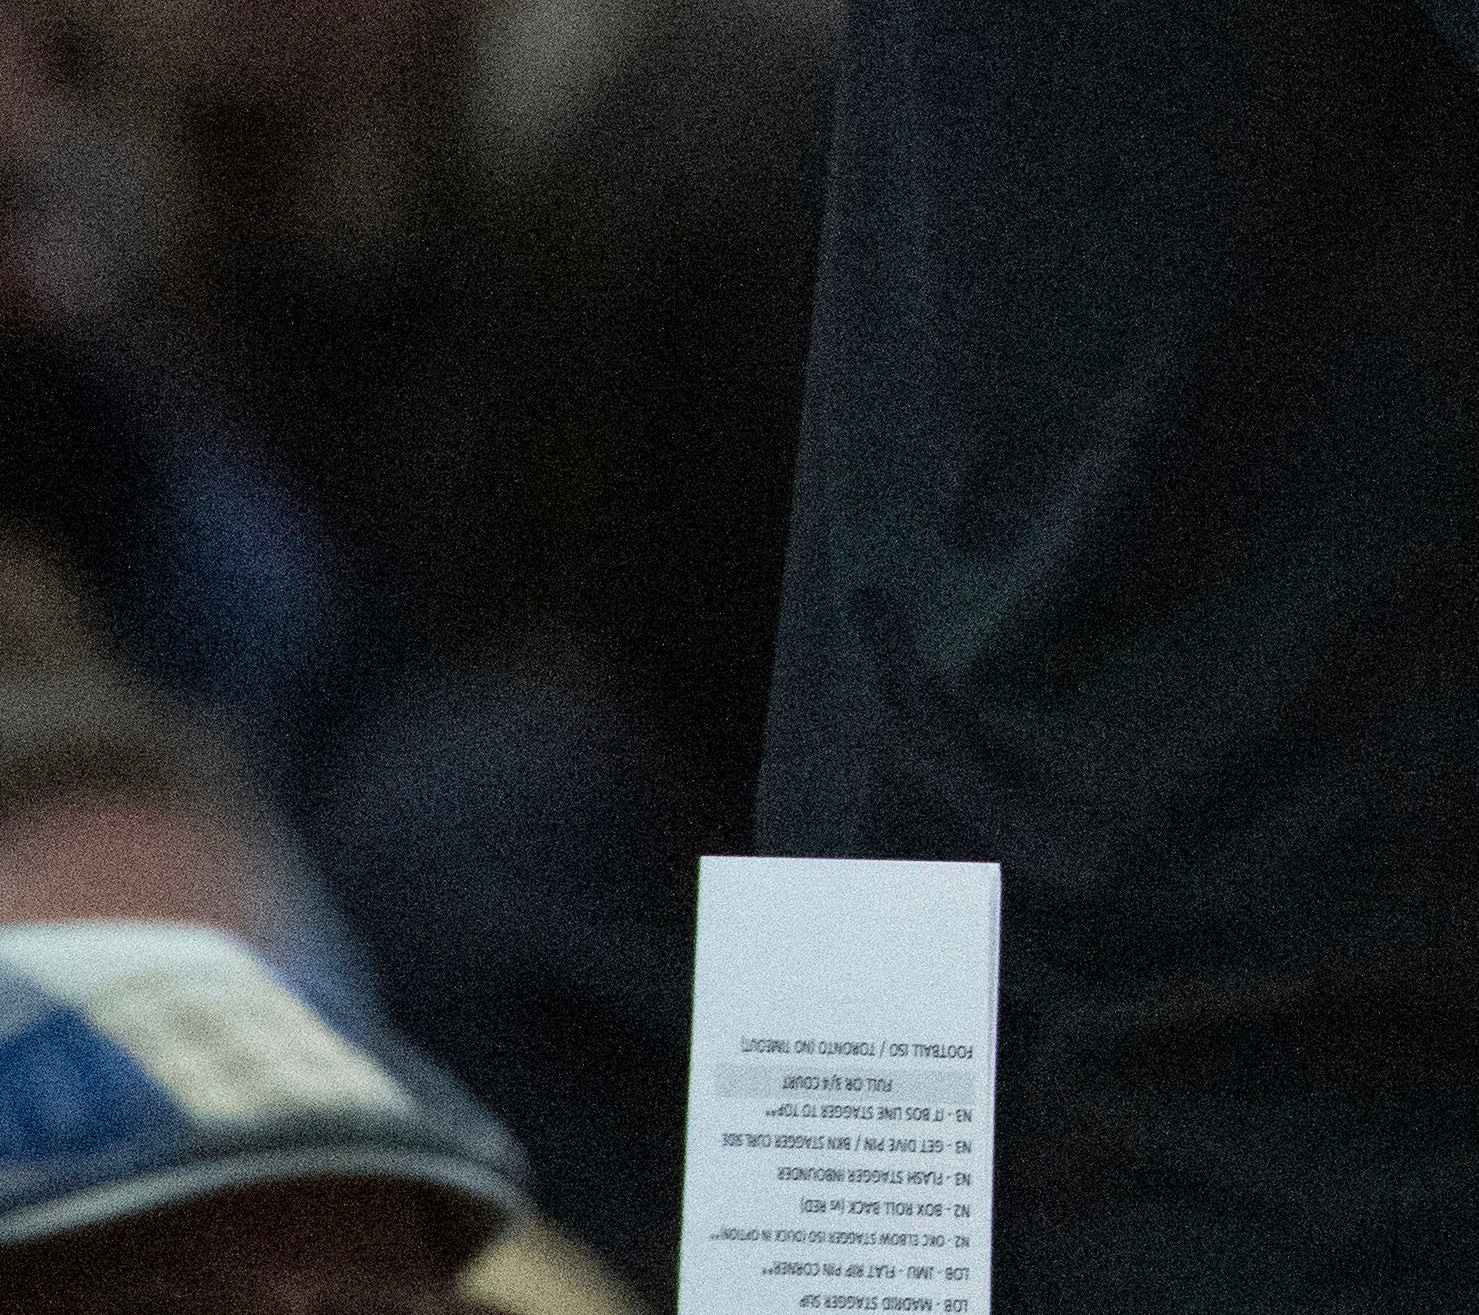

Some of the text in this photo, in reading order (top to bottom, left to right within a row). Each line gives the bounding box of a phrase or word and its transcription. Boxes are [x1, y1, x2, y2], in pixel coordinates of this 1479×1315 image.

[818, 1041, 875, 1056] TORONTO
[889, 1043, 908, 1057] ISO
[912, 1044, 973, 1059] FOOTBALL
[782, 1074, 892, 1093] FULL OR 3/4 COURT
[802, 1104, 817, 1118] TO
[821, 1105, 874, 1120] STAGGER
[877, 1106, 902, 1120] LINE
[905, 1107, 930, 1121] BOS
[956, 1109, 972, 1122] N3
[774, 1135, 824, 1150] STAGGER
[864, 1138, 884, 1151] PIN
[888, 1138, 917, 1152] DIVE
[920, 1140, 944, 1153] GET
[955, 1140, 972, 1154] N3
[848, 1169, 903, 1184] STAGGER
[908, 1171, 943, 1186] FLASH
[955, 1172, 970, 1186] N3
[848, 1201, 880, 1215] BACK
[885, 1202, 913, 1216] ROLL
[917, 1203, 942, 1217] BOX
[954, 1204, 970, 1218] N2
[829, 1232, 876, 1245] STAGGER
[880, 1233, 918, 1246] ELBOW
[955, 1236, 970, 1248] N2
[823, 1263, 841, 1277] PIN
[867, 1265, 896, 1279] FLAT
[945, 1267, 969, 1280] LOB
[824, 1295, 878, 1310] STAGGER
[882, 1297, 932, 1311] MADRID
[944, 1299, 968, 1312] LOB
